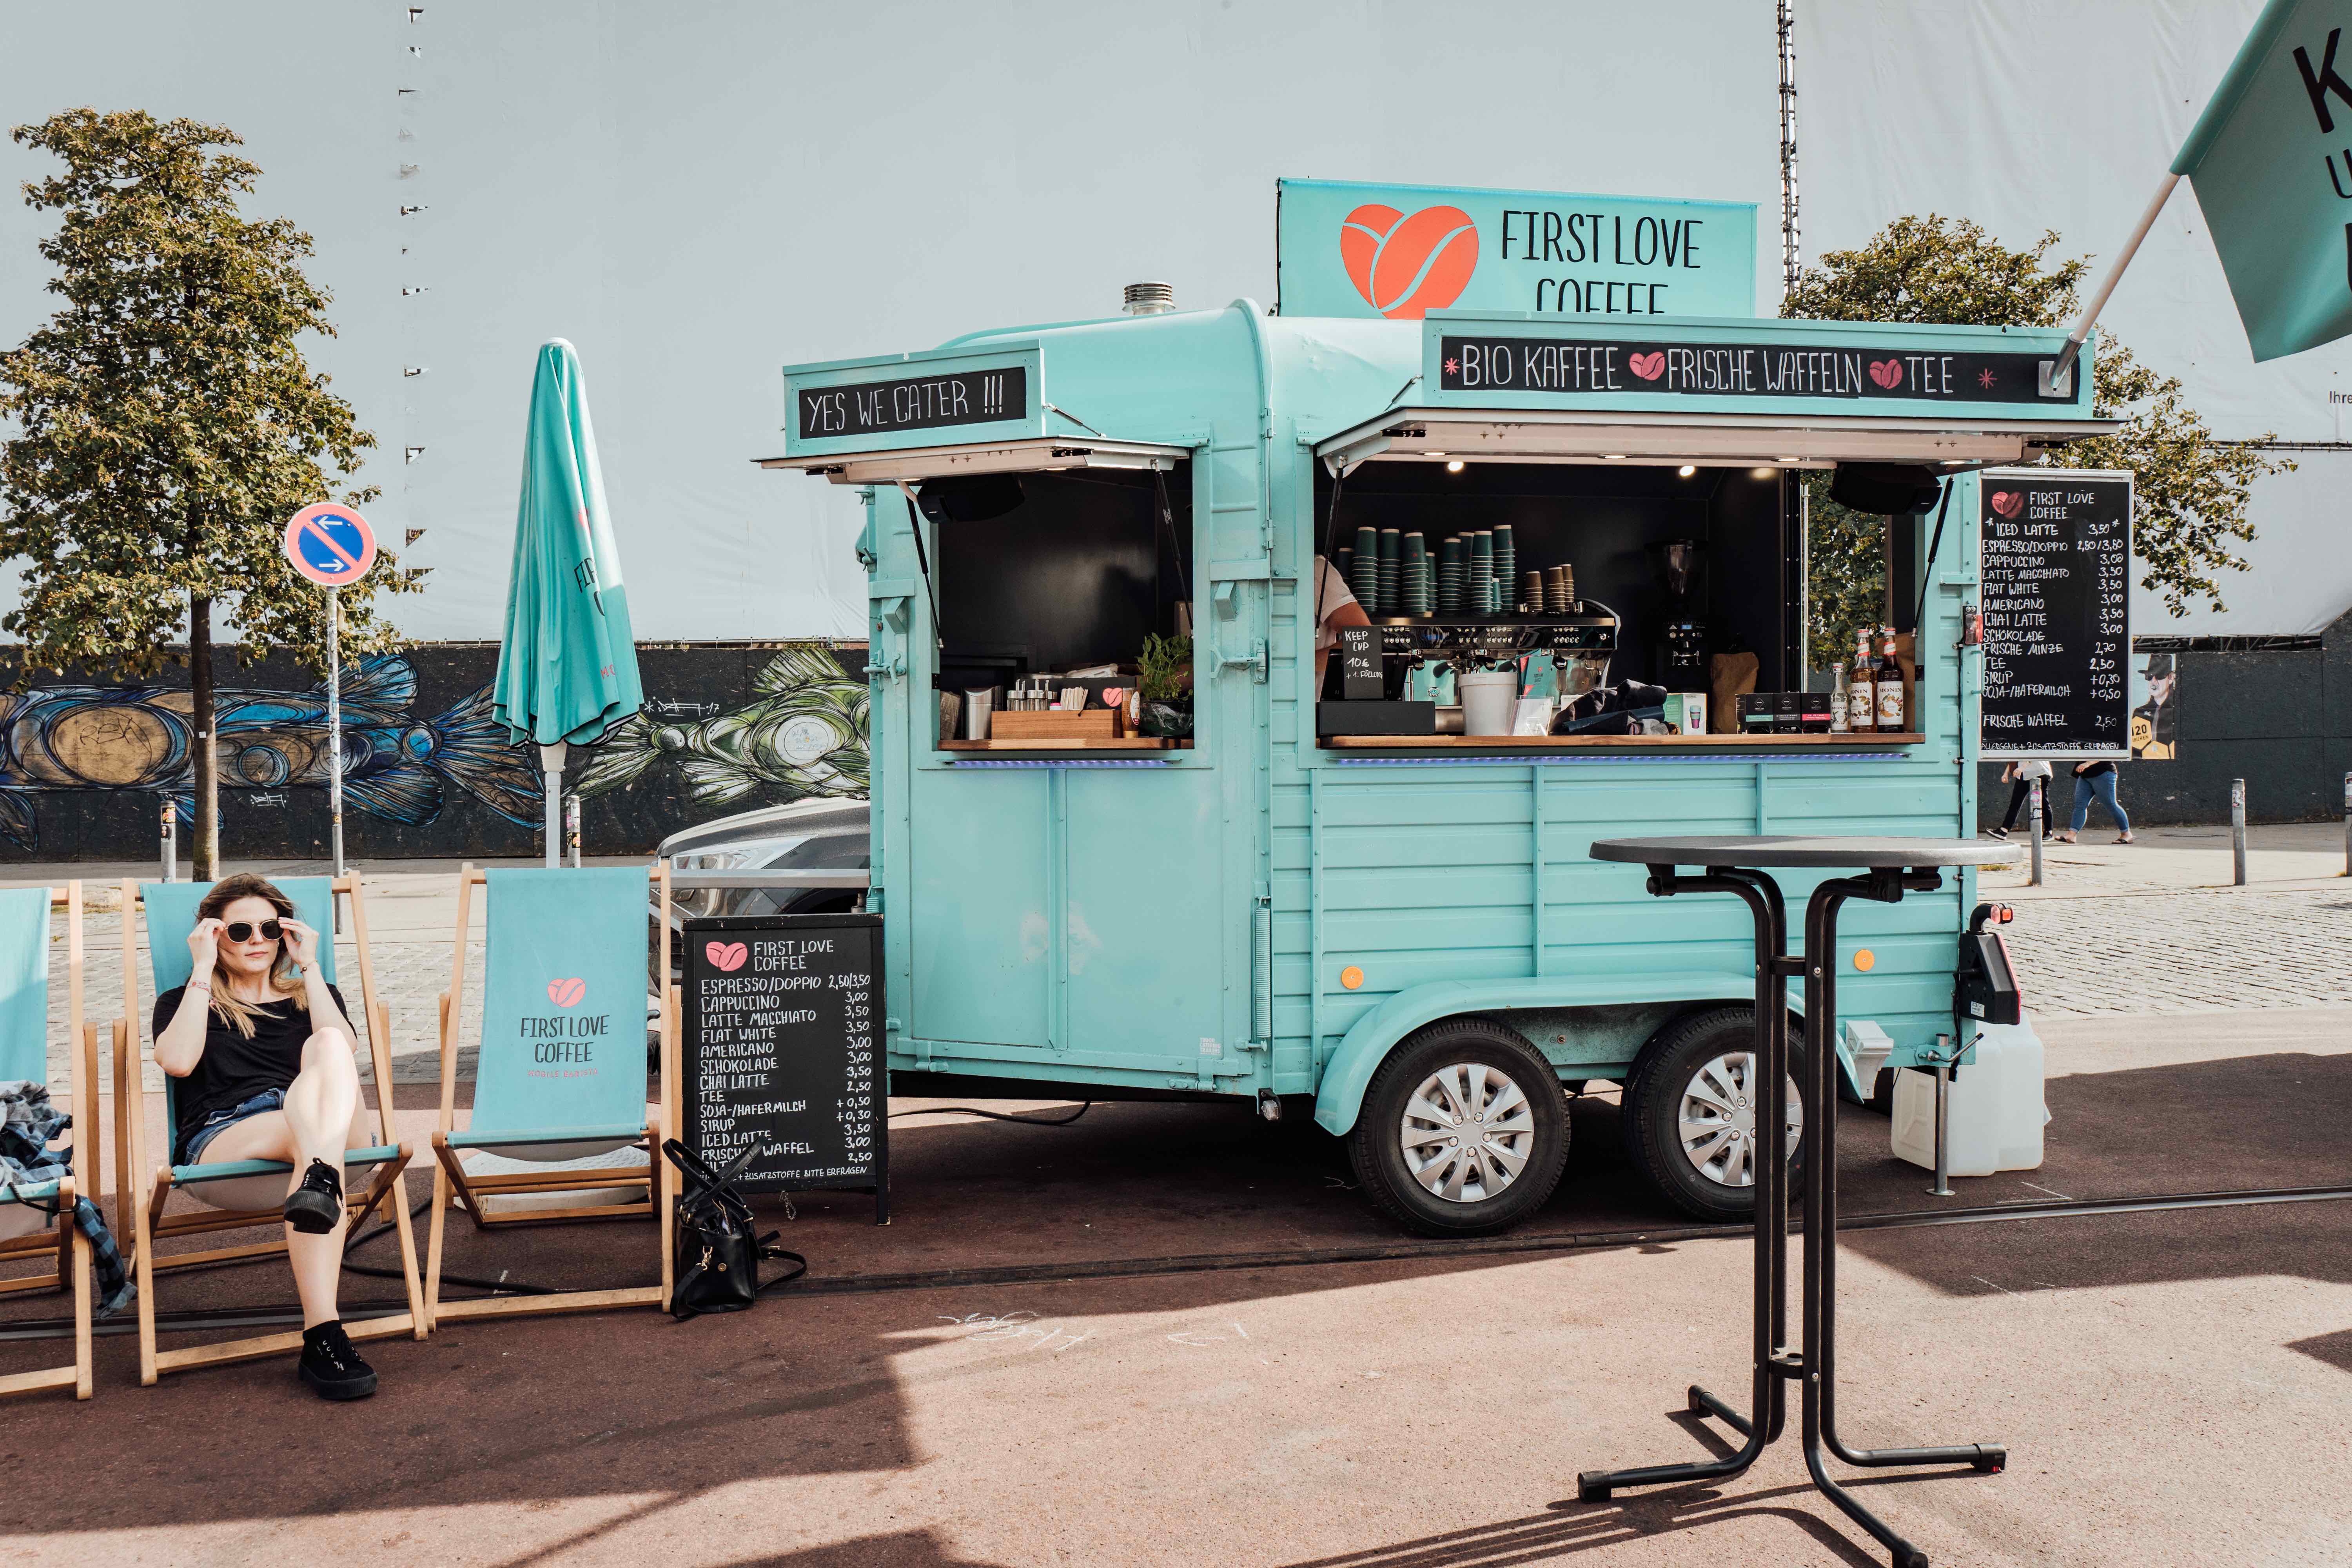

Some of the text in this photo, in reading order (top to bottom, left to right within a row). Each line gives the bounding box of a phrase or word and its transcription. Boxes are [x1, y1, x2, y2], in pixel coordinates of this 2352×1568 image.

[1503, 211, 1703, 268] FIRST LOVE
[1463, 345, 1953, 394] BIO KAFFEE FRISCHE WAFFELN TEE
[808, 393, 844, 431] YES
[857, 389, 887, 426] WE
[894, 381, 968, 422] CATER
[2030, 492, 2094, 505] FIRST LOVE
[2030, 506, 2068, 519] COFFEE
[1996, 523, 2109, 536] ICED LATTE 3,50
[1982, 540, 2067, 554] ESPRESSO/DOPPIO
[1983, 554, 2123, 568] CAPPUCCINO 3,00
[1982, 567, 2123, 581] LATTE MACCHIATO 3,50
[1984, 579, 2122, 595] FLAT WHITE 3,50
[1983, 593, 2123, 611] AMERICANO 3,00
[1985, 608, 2123, 626] CHAI LATTE 3,50
[1345, 631, 1368, 641] KEEP
[1983, 623, 2123, 642] SCHOKOLADE 3,00
[1353, 642, 1369, 651] CUP
[1983, 642, 2115, 655] FRISCHE MINZE 2,70
[1347, 657, 1369, 667] 10€
[1984, 657, 2114, 671] TEE 2,50
[1984, 671, 2013, 684] SIRUP
[1984, 713, 2116, 731] FRISCHE WAFFEL 2,50
[755, 940, 833, 955] FIRST LOVE
[755, 955, 806, 971] COFFEE
[702, 973, 870, 994] ESPRESSO/DOPPIO 2,50/3,50
[701, 991, 867, 1012] CAPPUCCINO 3,00
[702, 1005, 869, 1027] LATTE MACCHIATO 3,50
[521, 1015, 610, 1038] FIRST LOVE
[702, 1021, 869, 1043] FLAT WHITE 3,50
[535, 1042, 593, 1063] COFFEE
[701, 1036, 871, 1058] AMERICANO 3,00
[701, 1051, 871, 1074] SCHOKOLADE 3,00
[564, 1067, 598, 1077] BARISTA
[700, 1066, 871, 1090] CHAI LATTE 3,50
[699, 1081, 871, 1102] TEE 2,50
[701, 1118, 735, 1132] SIRUP
[702, 1133, 730, 1147] ICED
[844, 1124, 870, 1135] 3,50
[763, 1142, 814, 1156] WAFFEL
[845, 1137, 870, 1148] 3,00
[848, 1152, 872, 1163] 2,50
[744, 1170, 800, 1180] ZUSATZSTOFFE
[827, 1167, 867, 1176] ERFRAGEN
